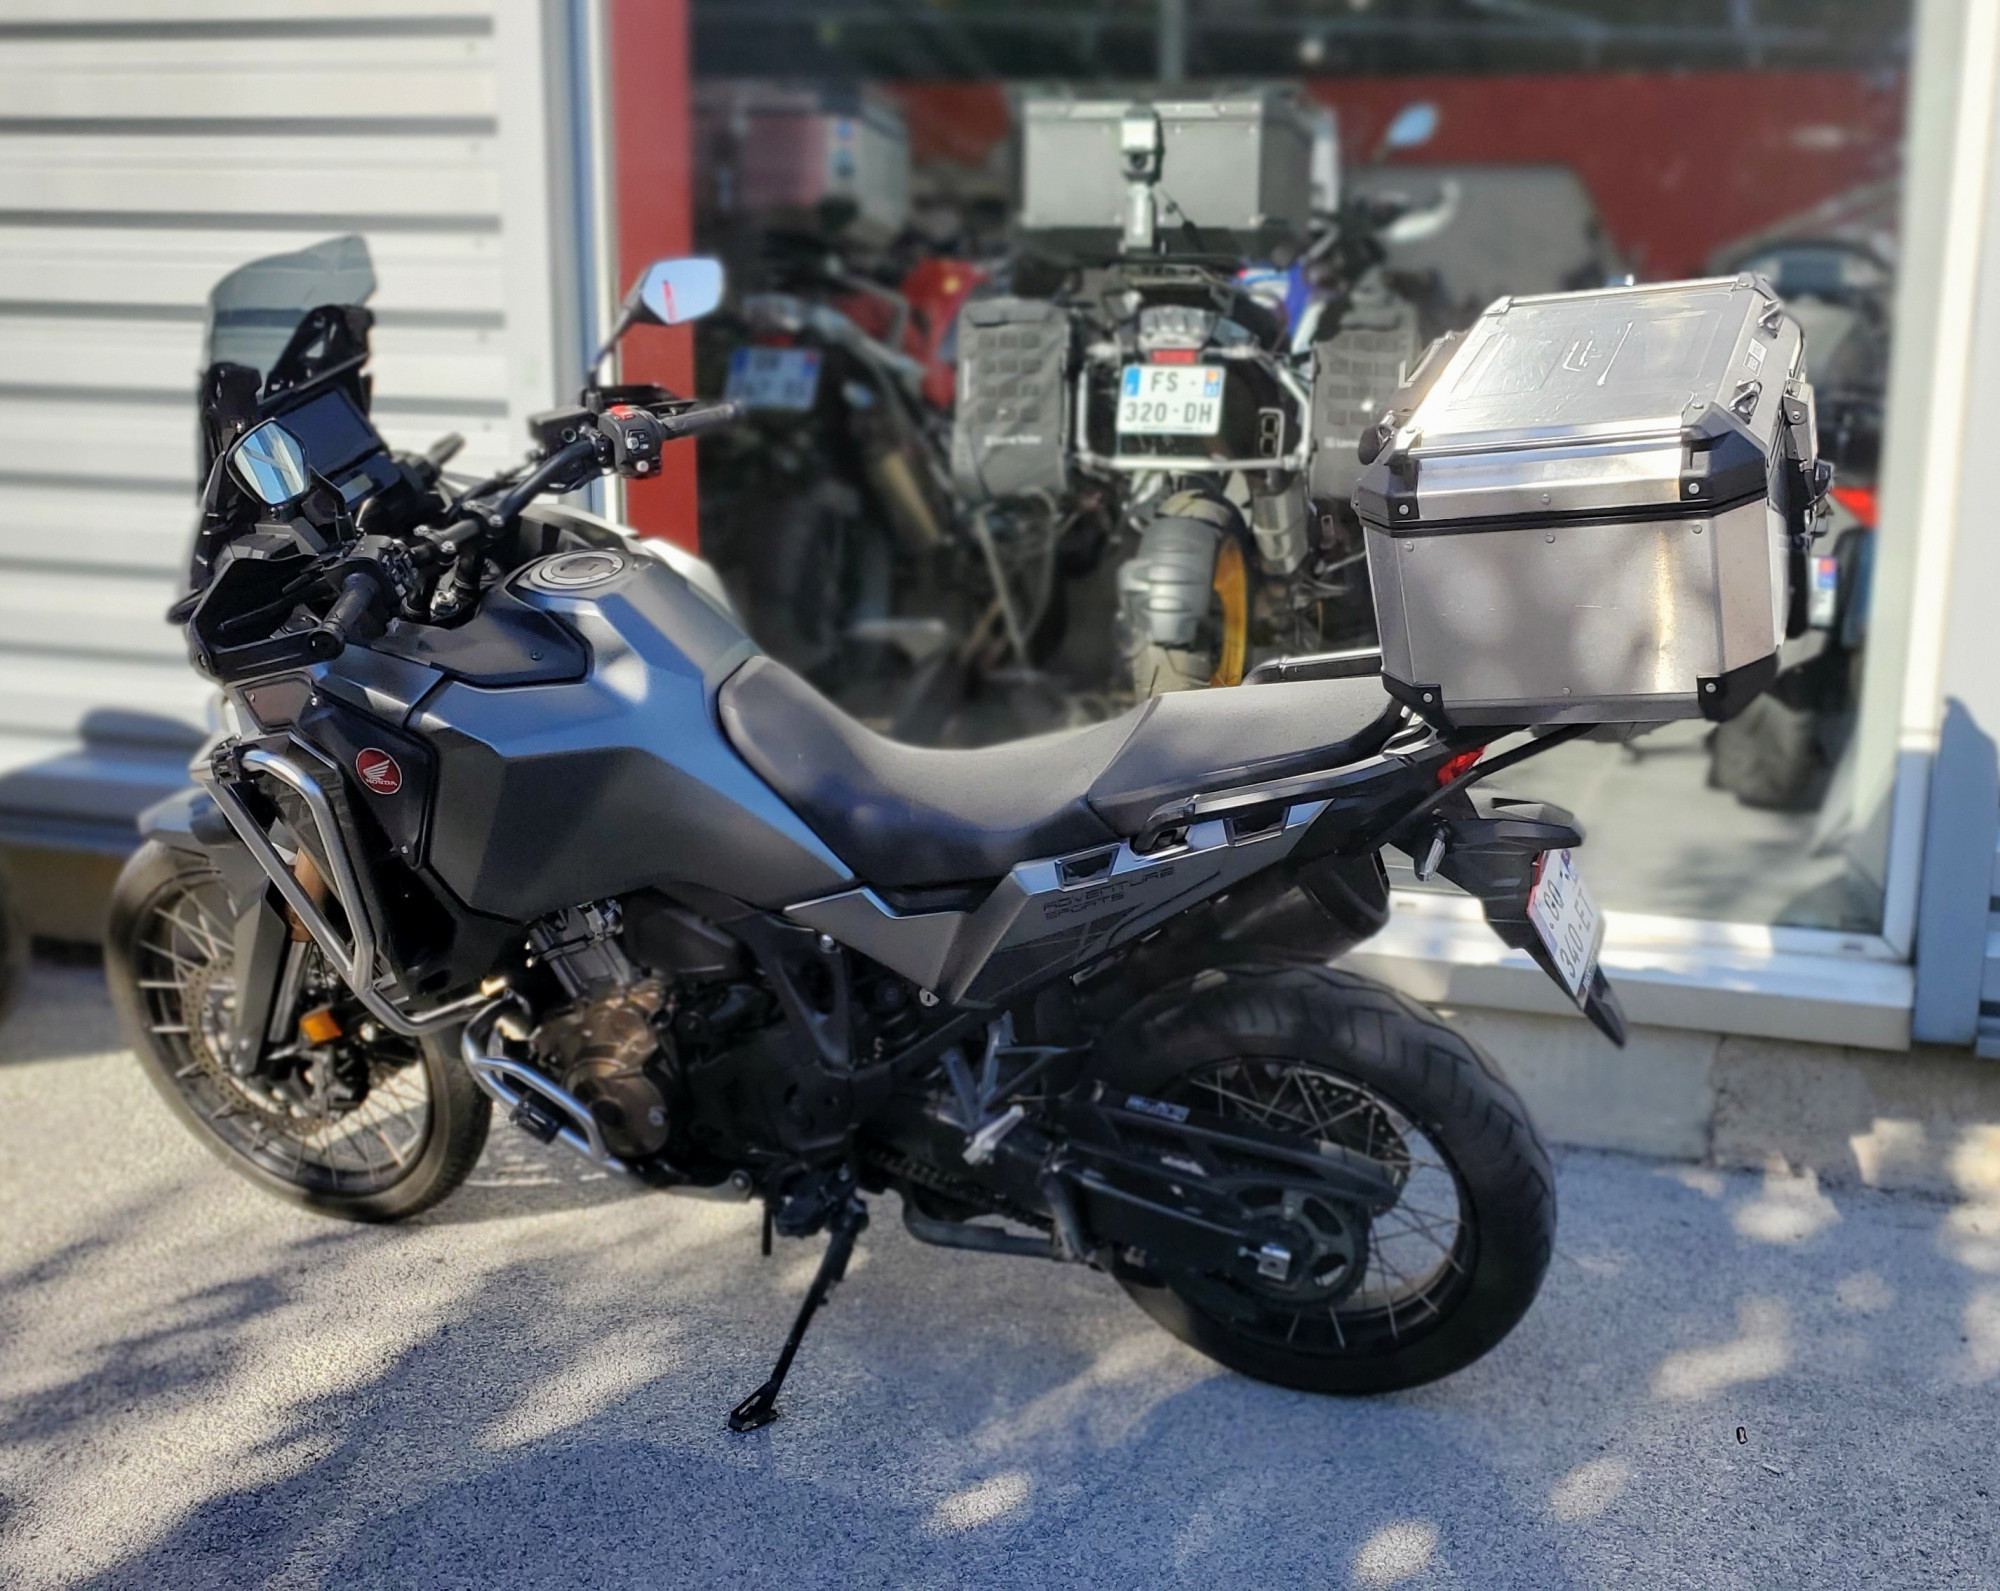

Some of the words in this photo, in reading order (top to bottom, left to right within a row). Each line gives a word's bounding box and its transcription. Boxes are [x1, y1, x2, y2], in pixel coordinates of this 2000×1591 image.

[1125, 402, 1212, 423] 320-DH
[365, 778, 398, 787] HONDA
[1043, 867, 1175, 911] ADVENTURE
[1045, 892, 1124, 921] SPORTS
